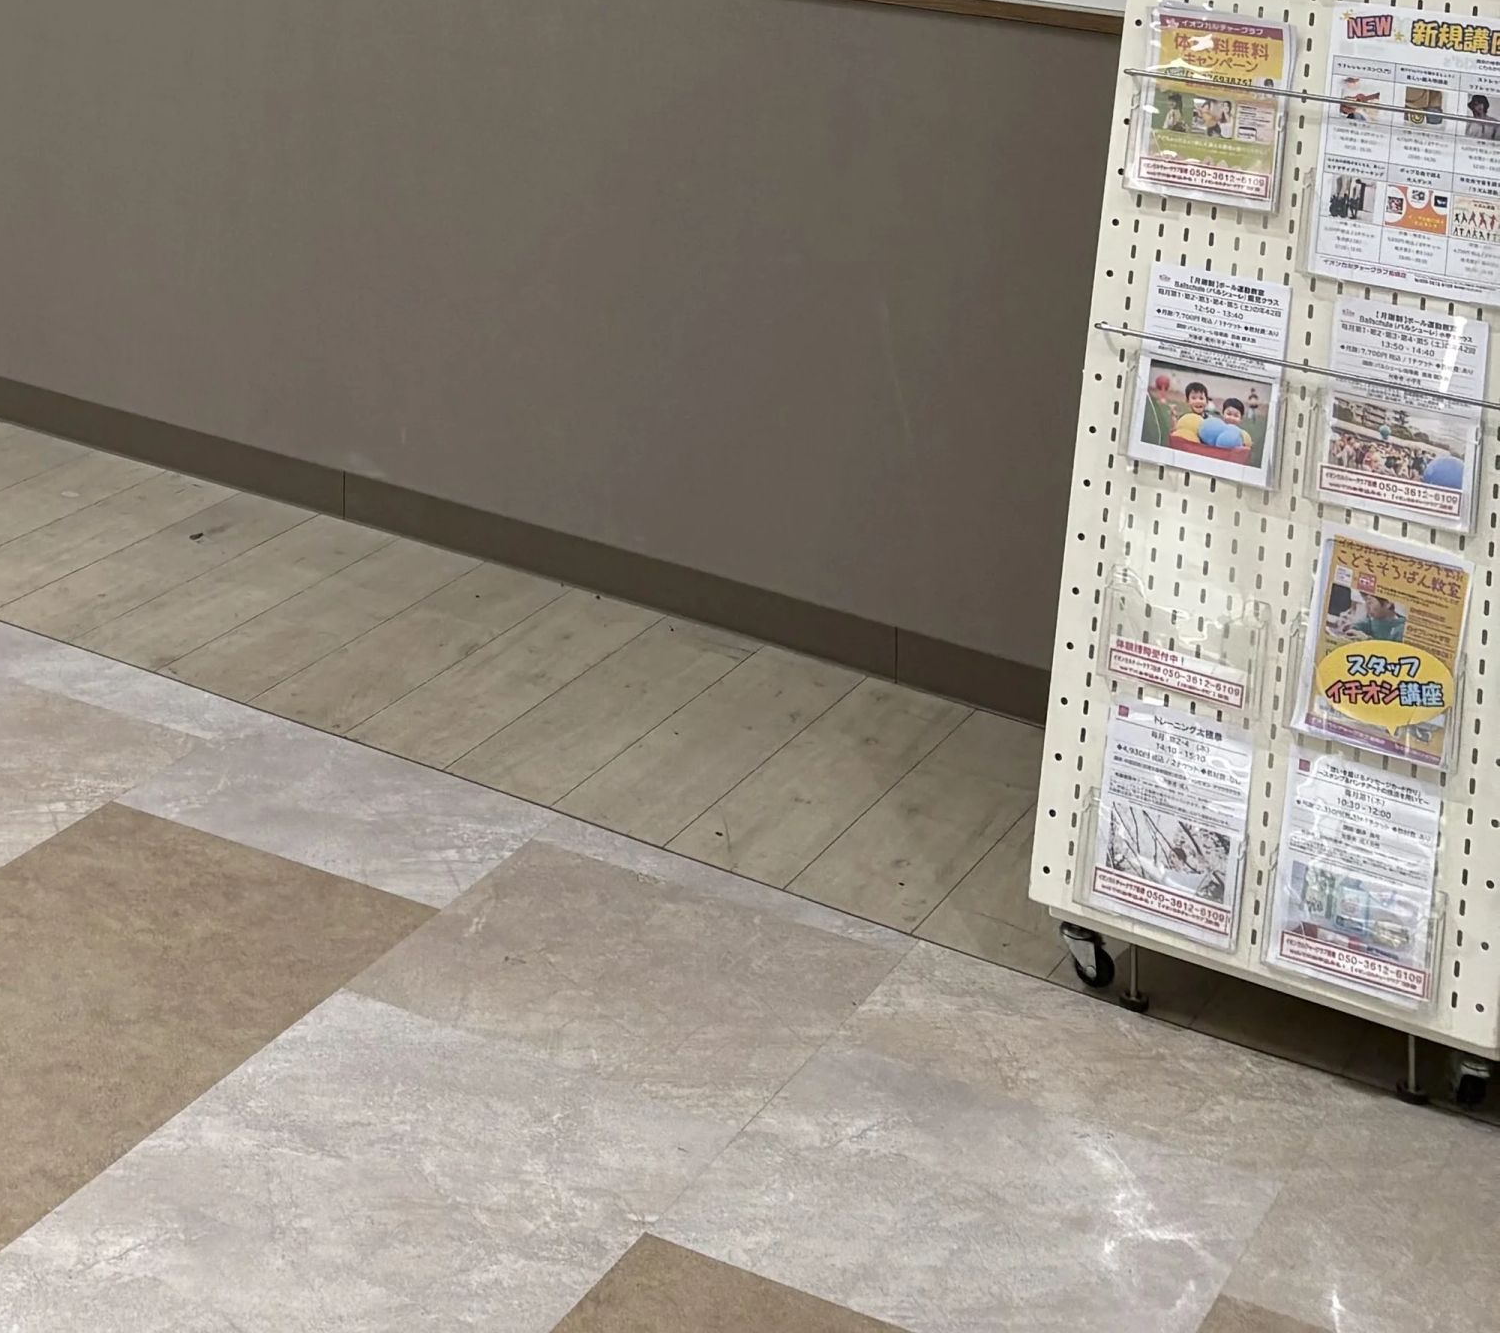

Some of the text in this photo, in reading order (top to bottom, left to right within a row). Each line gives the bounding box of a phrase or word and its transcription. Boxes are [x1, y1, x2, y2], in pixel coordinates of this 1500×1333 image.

[1181, 20, 1263, 34] イオンカルチャークラブ
[1347, 15, 1393, 39] NEW
[1175, 33, 1269, 61] 体料無料
[1184, 53, 1258, 72] キャンペーン
[1194, 305, 1243, 319] 12:50 13:40
[1359, 316, 1394, 328] Ballschule
[1381, 340, 1435, 357] 13:50 14:40
[1379, 482, 1458, 505] 050-3612-6109
[1337, 549, 1461, 599] こどもそろばん教室
[1346, 655, 1420, 678] スタッフ
[1162, 668, 1240, 696] 050-3612-6109
[1325, 680, 1444, 707] イチオシ講座
[1152, 731, 1165, 741] 毎月
[1154, 716, 1222, 741] トレーニング太極拳
[1156, 743, 1206, 762] 14:10 15:10
[1337, 797, 1391, 820] 10:30 12:00
[1146, 890, 1225, 922] 050-3612-6109
[1338, 951, 1422, 984] 050-3612-6109
